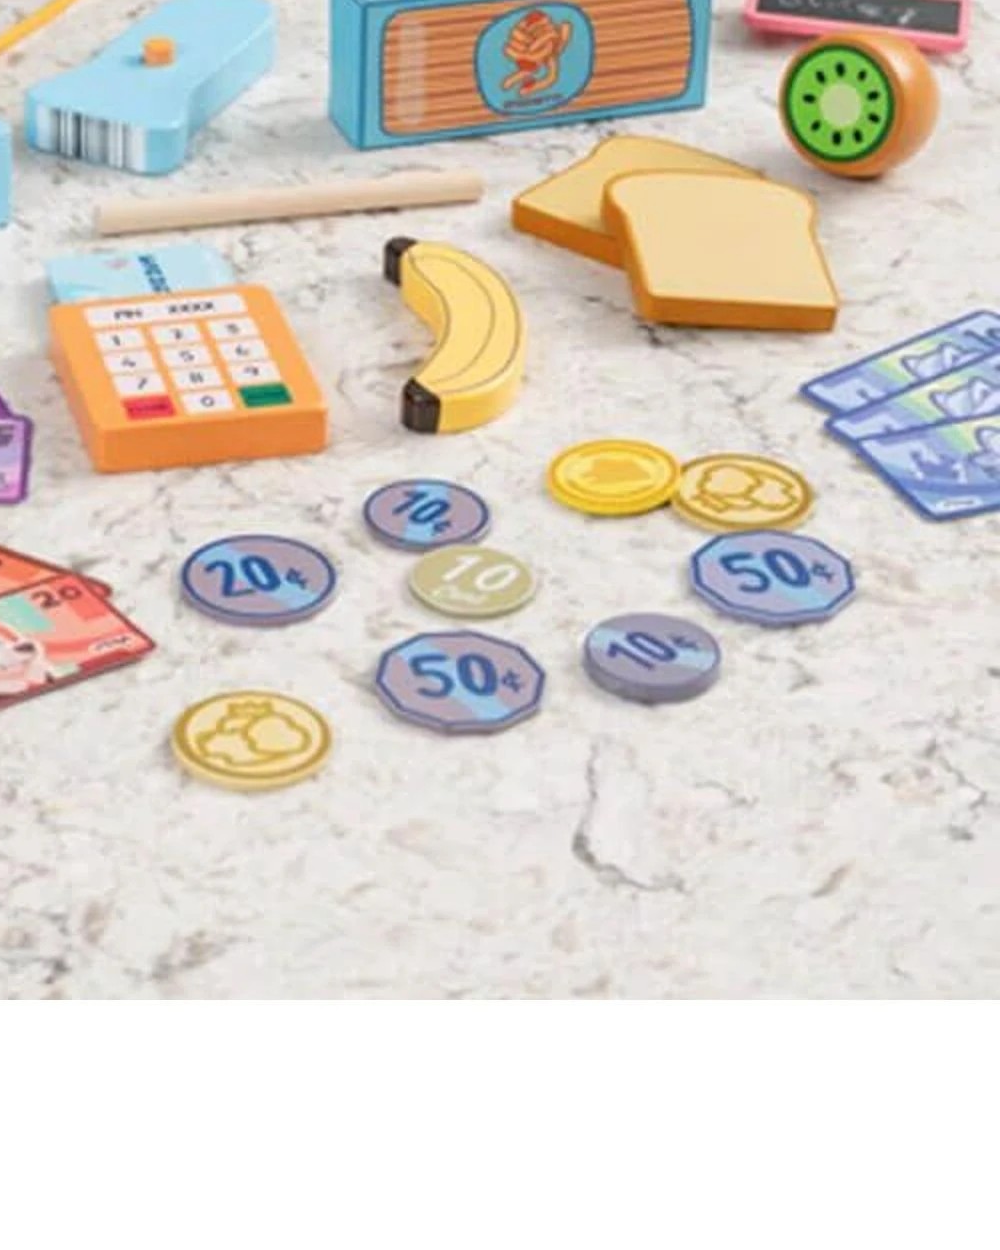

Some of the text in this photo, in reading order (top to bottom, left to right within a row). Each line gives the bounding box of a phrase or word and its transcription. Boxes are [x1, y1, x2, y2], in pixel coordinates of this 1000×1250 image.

[200, 394, 215, 408] 0
[441, 555, 521, 591] 10
[29, 585, 83, 610] 20
